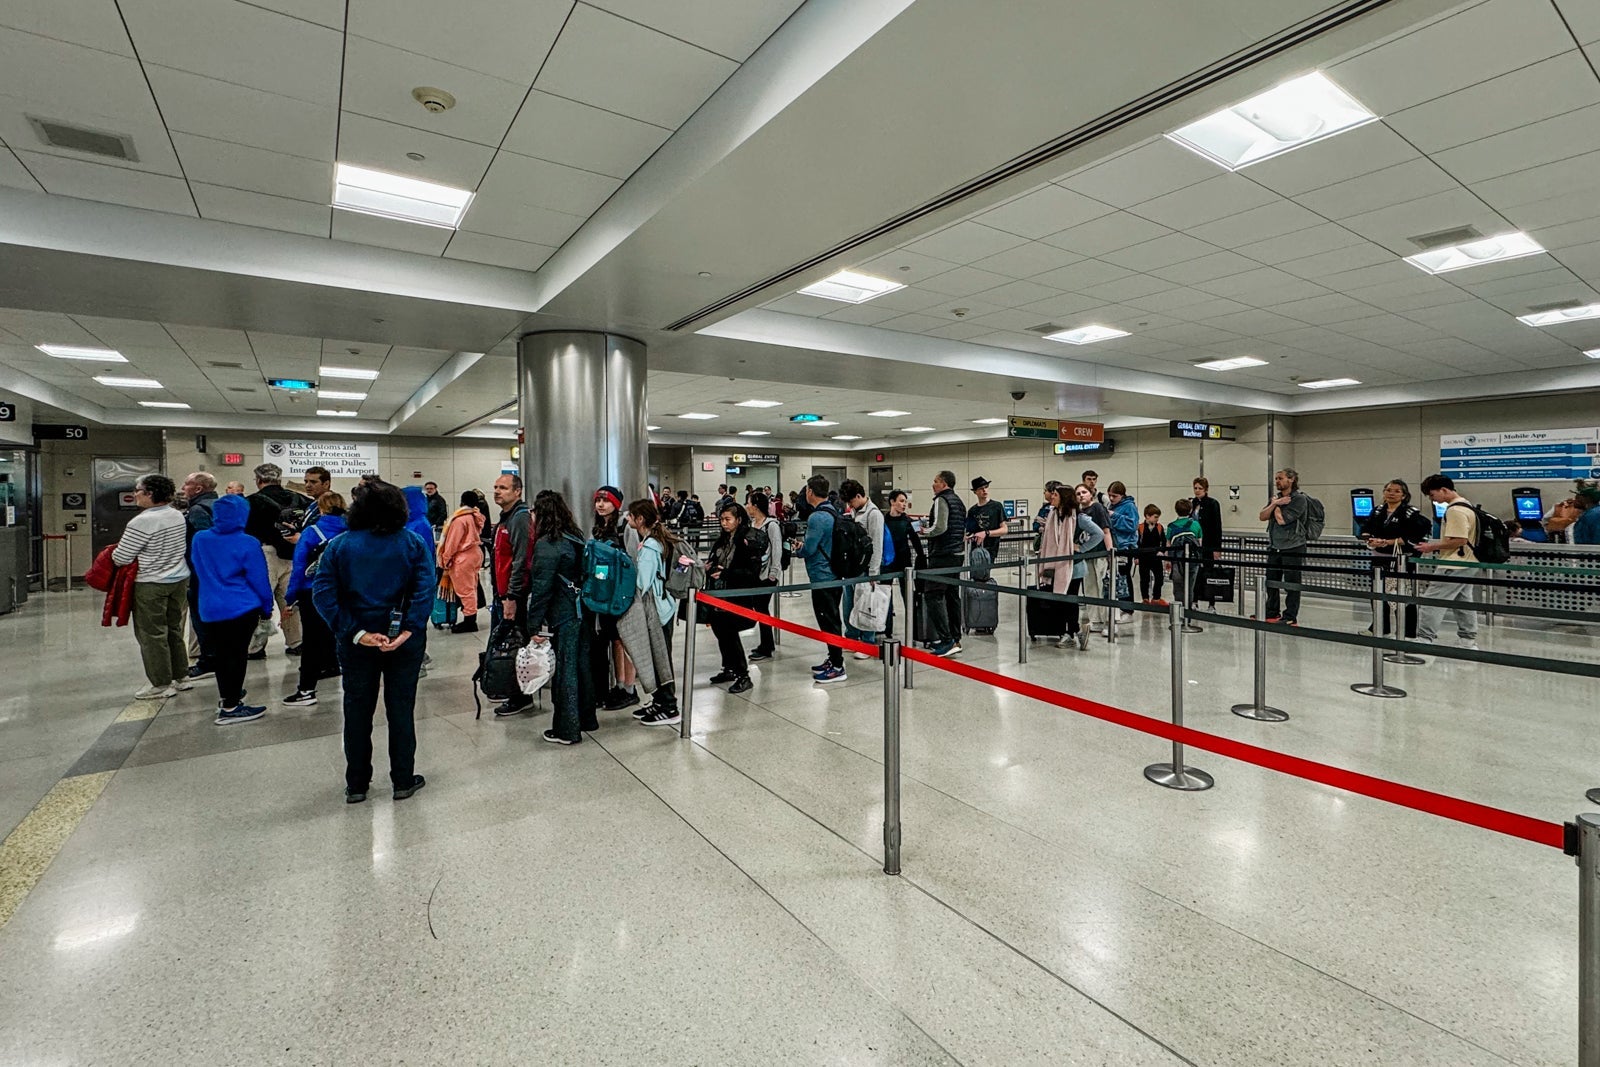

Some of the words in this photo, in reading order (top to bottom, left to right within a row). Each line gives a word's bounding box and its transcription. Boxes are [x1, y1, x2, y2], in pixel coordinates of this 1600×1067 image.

[1022, 420, 1047, 428] DIPLOMATS
[1177, 422, 1194, 430] GLOBAL
[1194, 423, 1208, 431] ENTRY
[65, 428, 83, 438] 50
[1073, 427, 1094, 437] CREW
[1531, 432, 1547, 440] App
[289, 442, 304, 450] U.S.
[320, 450, 361, 458] Protection
[289, 458, 339, 467] Washington
[341, 459, 367, 467] Dulles
[346, 466, 375, 476] Airport
